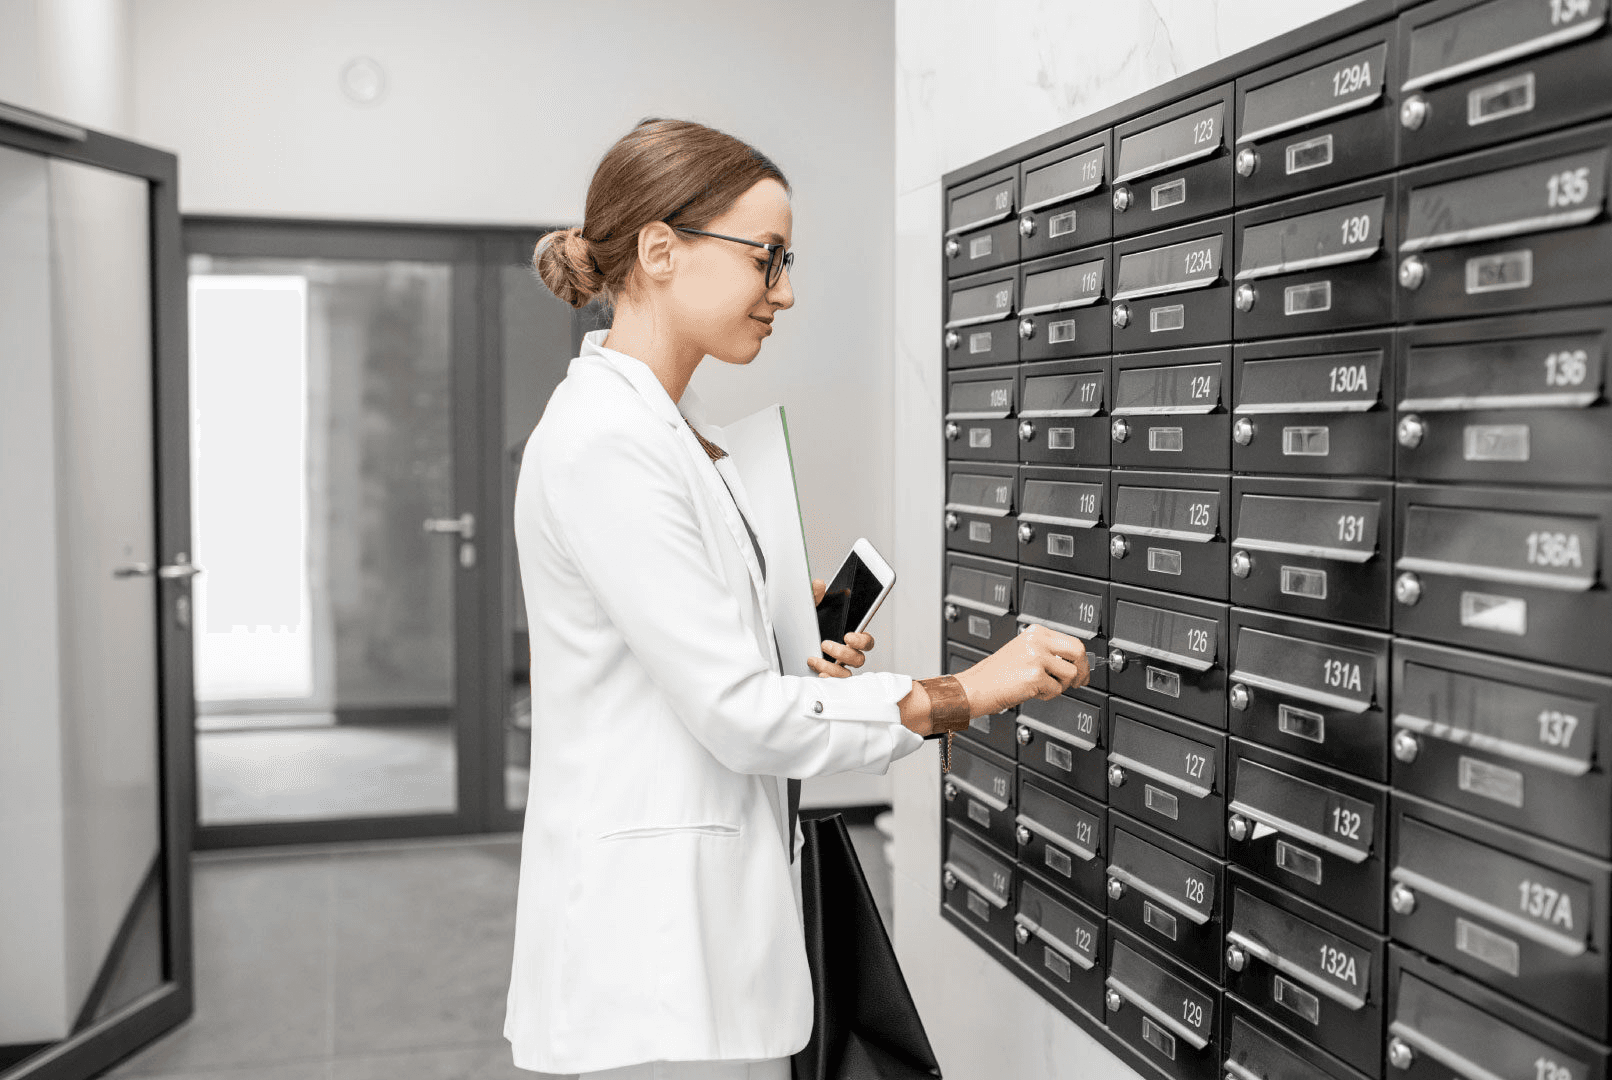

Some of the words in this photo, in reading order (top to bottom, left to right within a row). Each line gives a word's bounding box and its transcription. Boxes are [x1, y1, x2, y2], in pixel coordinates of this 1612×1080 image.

[1332, 62, 1371, 97] 129A
[1194, 118, 1213, 144] 123
[1082, 160, 1097, 182] 115
[1547, 167, 1590, 207] 135
[1341, 215, 1369, 244] 130
[1184, 248, 1212, 274] 123A
[1082, 272, 1096, 290] 116
[996, 290, 1008, 308] 109
[1329, 365, 1368, 392] 130A
[1545, 350, 1587, 386] 136
[990, 389, 1008, 406] 109A
[1081, 383, 1096, 402] 117
[1190, 376, 1210, 398] 124
[996, 486, 1008, 504] 110
[1080, 494, 1094, 514] 118
[1190, 504, 1210, 526] 125
[1338, 515, 1364, 542] 131
[1526, 532, 1582, 568] 136A
[994, 584, 1006, 602] 111
[1079, 602, 1094, 624] 119
[1188, 628, 1208, 652] 126
[1324, 658, 1361, 691] 131A
[1077, 712, 1092, 734] 120
[1538, 710, 1578, 748] 137
[1185, 752, 1206, 778] 127
[993, 776, 1006, 796] 113
[1076, 820, 1091, 844] 121
[1332, 808, 1360, 840] 132
[1185, 877, 1204, 904] 128
[1519, 881, 1573, 929] 137A
[1075, 927, 1090, 952] 122
[1320, 944, 1356, 986] 132A
[1182, 998, 1202, 1027] 129
